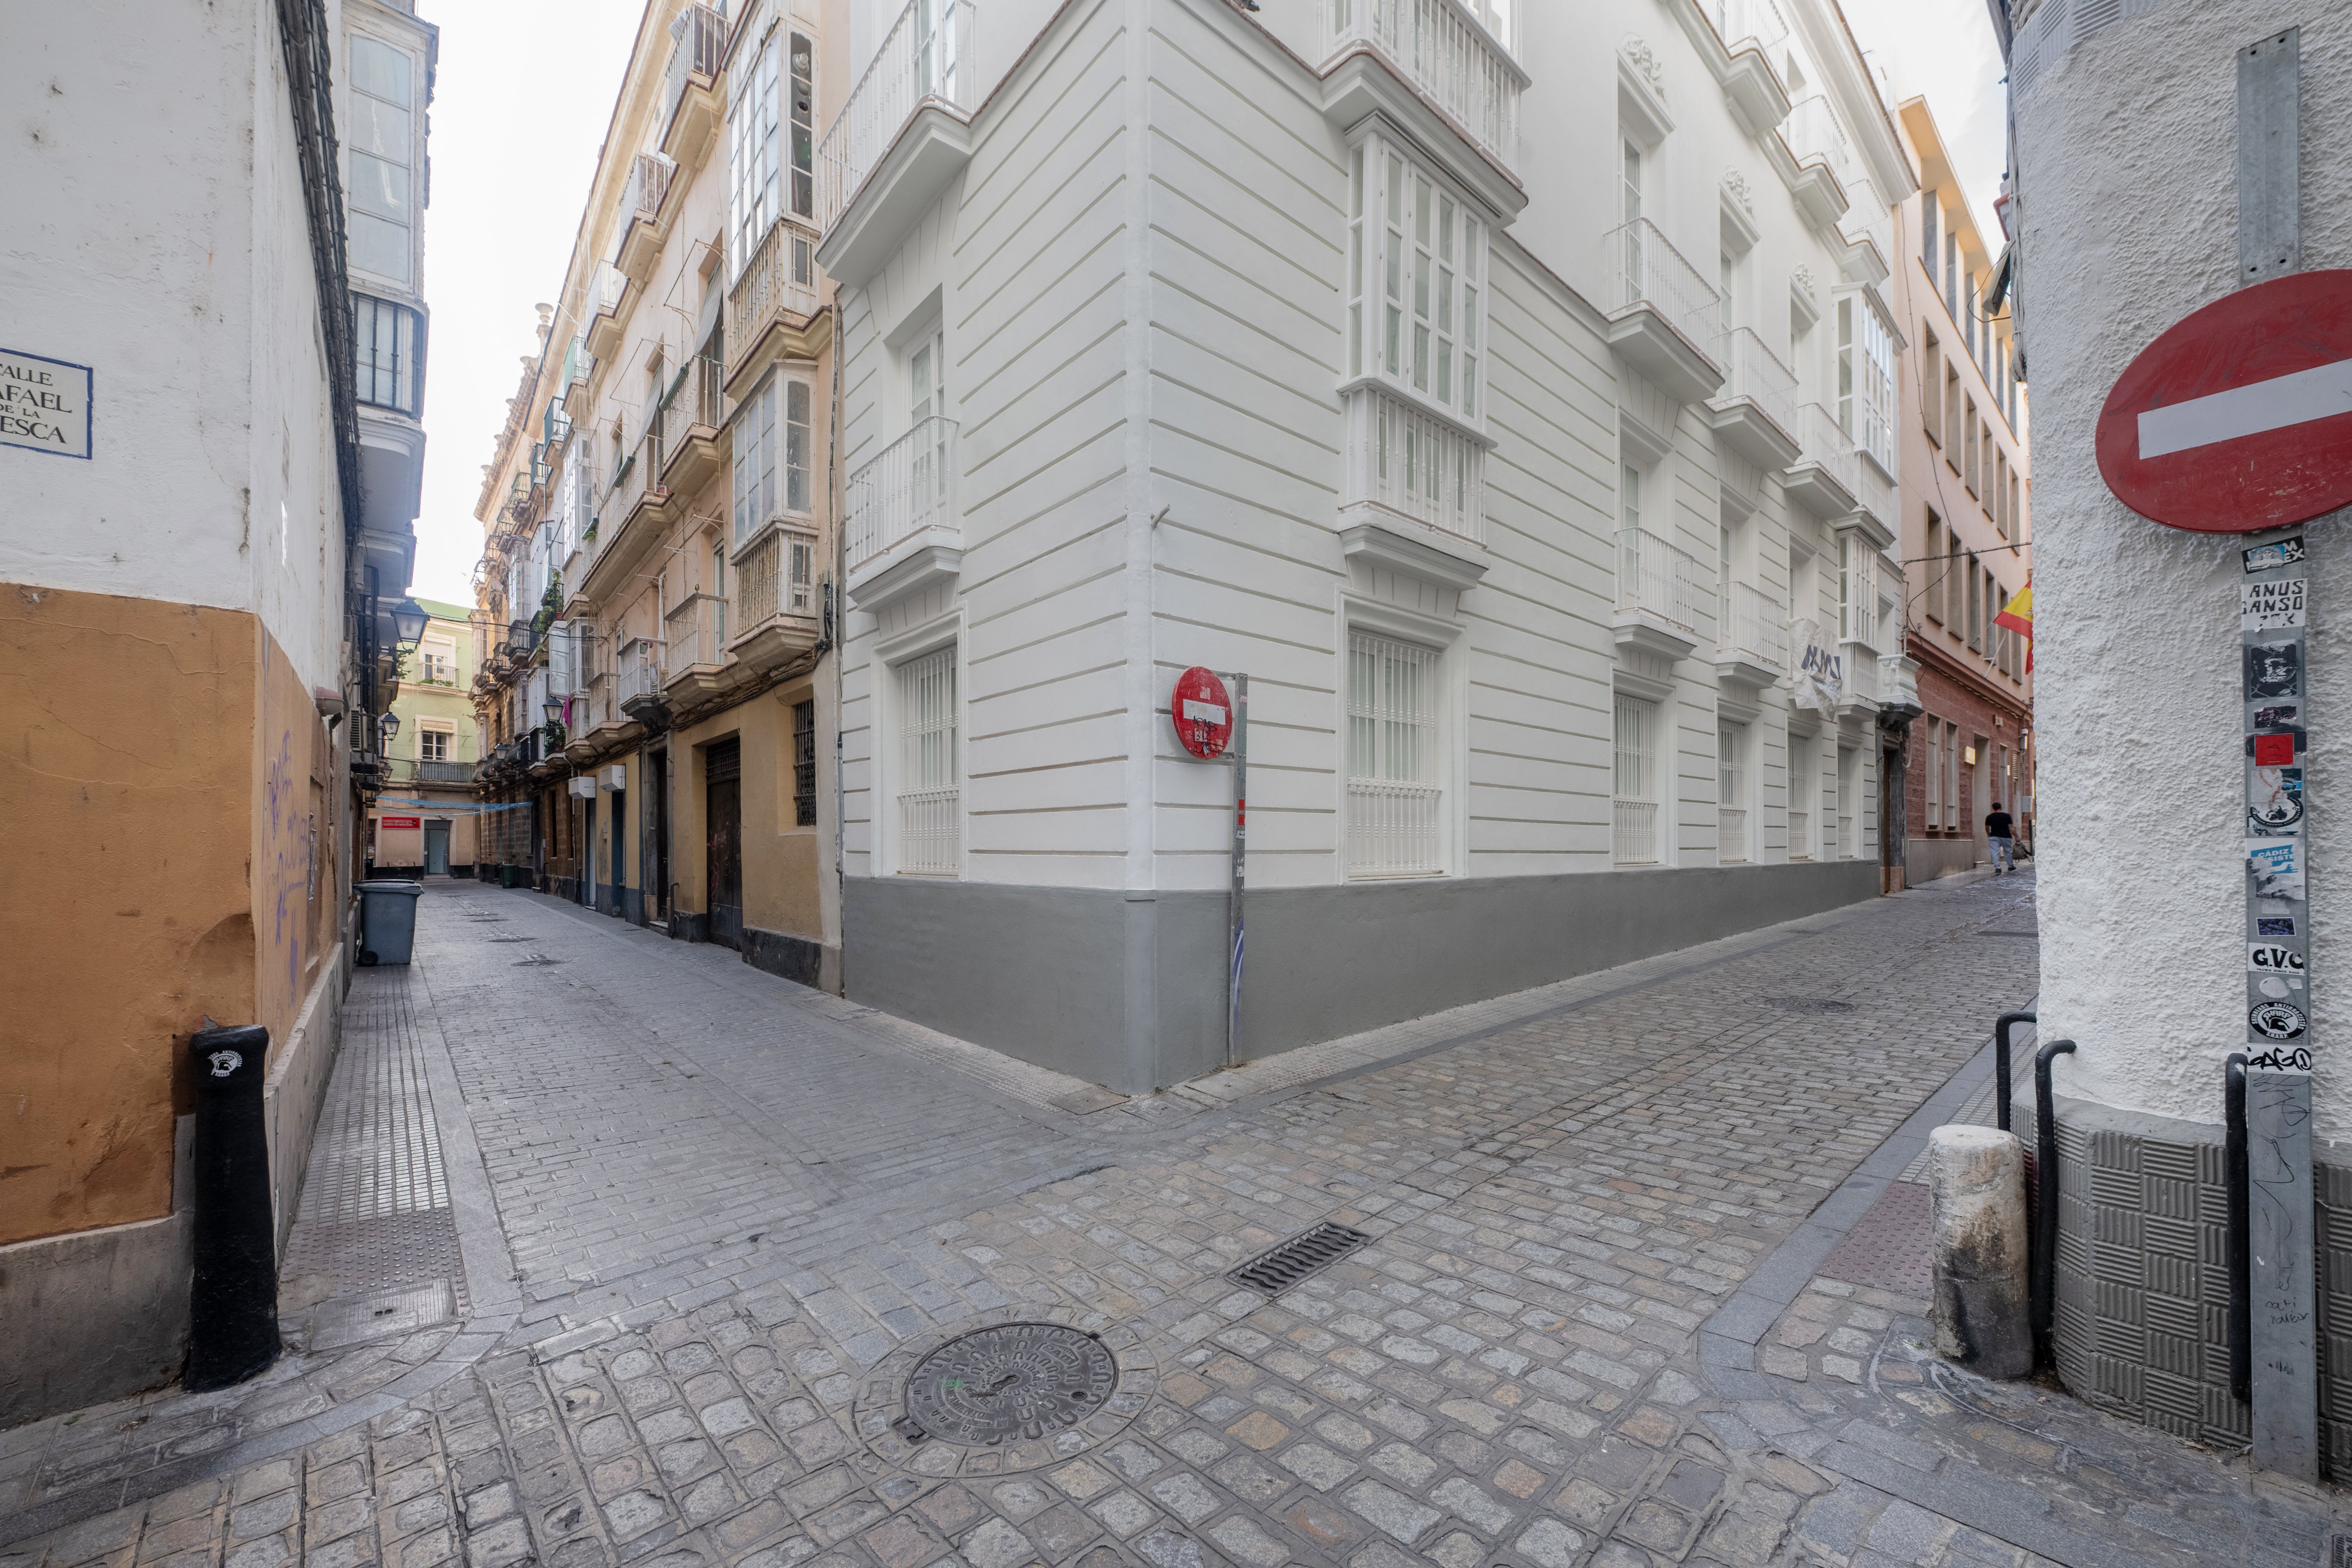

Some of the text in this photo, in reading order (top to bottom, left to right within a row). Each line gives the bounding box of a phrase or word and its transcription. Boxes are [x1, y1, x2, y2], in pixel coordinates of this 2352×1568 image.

[0, 364, 53, 386] ALLE
[23, 408, 41, 419] LA
[2249, 580, 2304, 597] ANUS
[2258, 849, 2289, 857] CÁDIZ
[2251, 1003, 2270, 1024] SKINHEADS
[2263, 1010, 2292, 1021] SHARP
[944, 1381, 985, 1418] SANEAMIENTO
